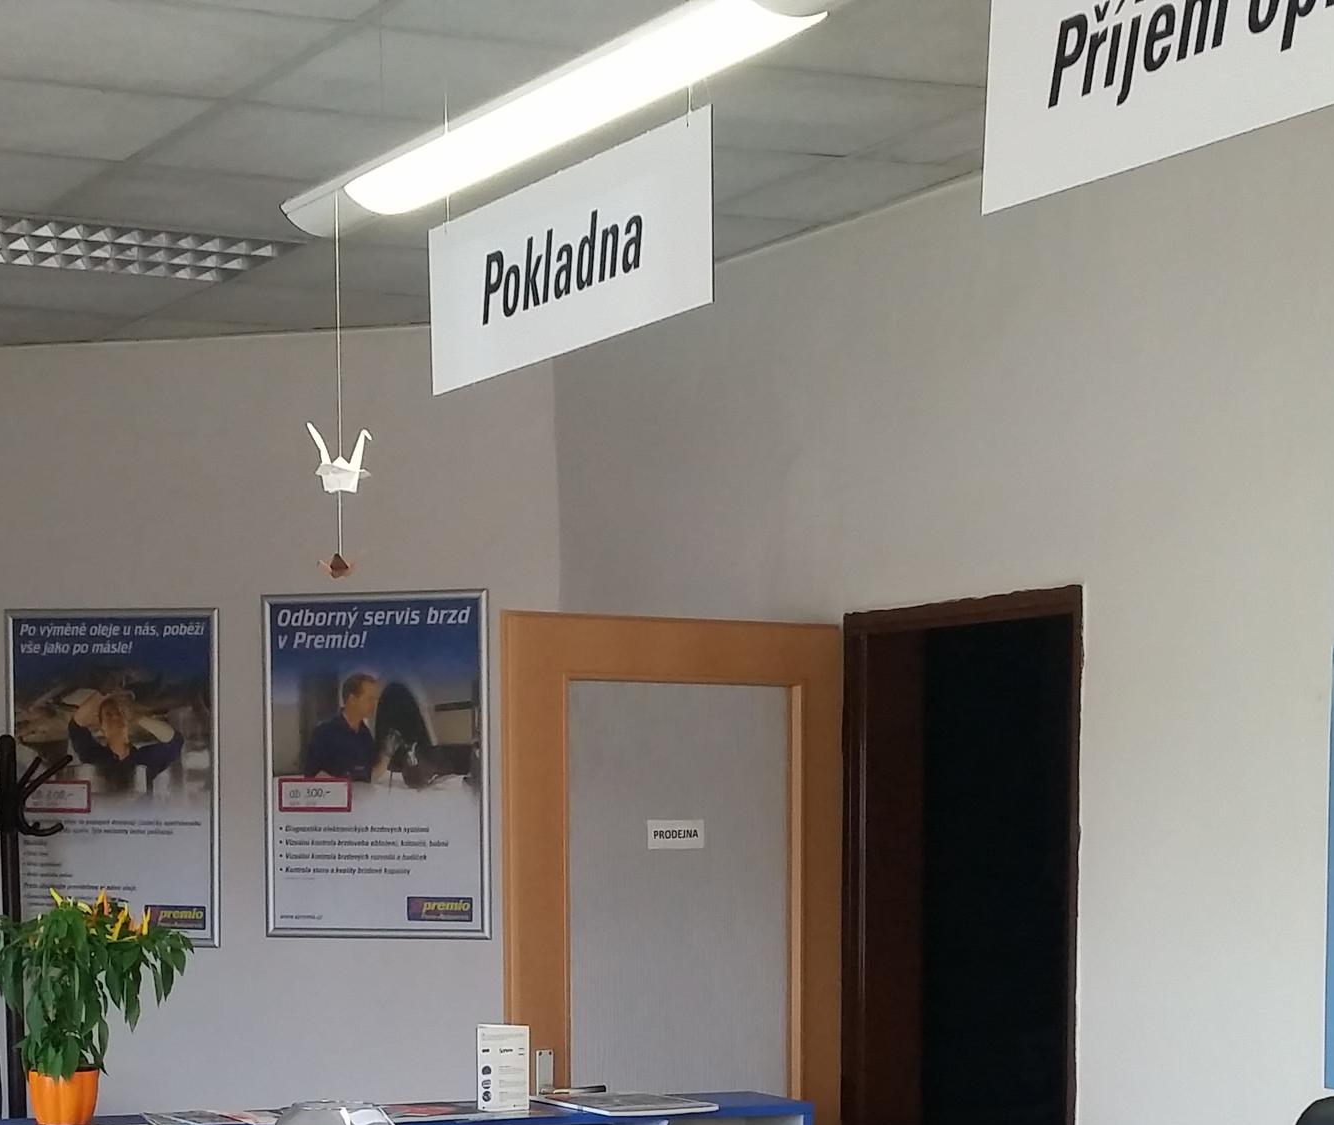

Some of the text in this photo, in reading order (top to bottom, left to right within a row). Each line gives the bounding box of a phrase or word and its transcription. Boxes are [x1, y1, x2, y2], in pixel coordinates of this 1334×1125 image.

[1048, 0, 1229, 109] Příjem
[482, 208, 644, 327] Pokladna
[277, 606, 471, 629] Odborný servis brzd
[20, 622, 205, 638] Po výměně oleje u nás, poběží
[20, 641, 132, 656] vše jako po másle!
[278, 631, 367, 649] v Premio!
[654, 829, 698, 839] PRODEJNA
